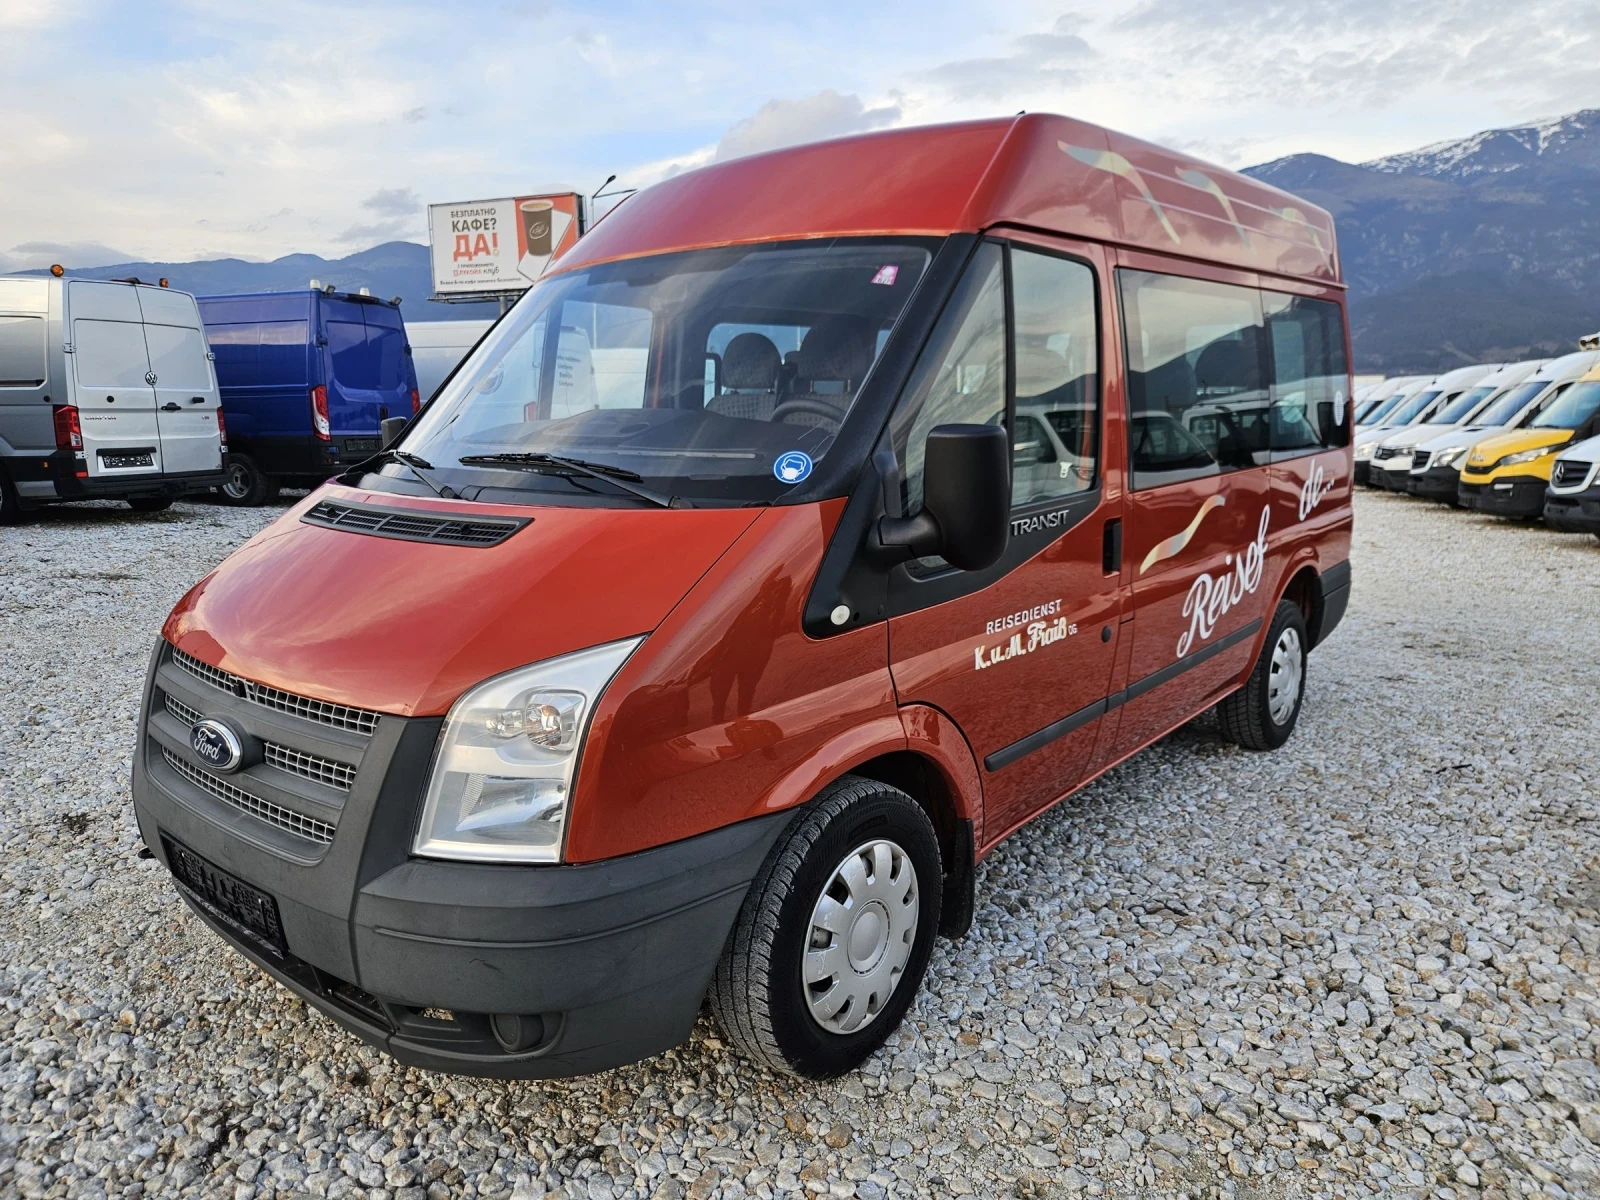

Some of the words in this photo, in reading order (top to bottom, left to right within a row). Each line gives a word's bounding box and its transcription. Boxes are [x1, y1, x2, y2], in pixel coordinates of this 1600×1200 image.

[450, 208, 496, 218] БЕЗПЛАТНО
[452, 217, 497, 233] КАФЕ?
[453, 232, 499, 262] ДА!
[1011, 509, 1070, 536] TRANSIT
[986, 599, 1063, 635] REISEDIENST
[1068, 623, 1078, 636] OG
[194, 728, 222, 760] Ford
